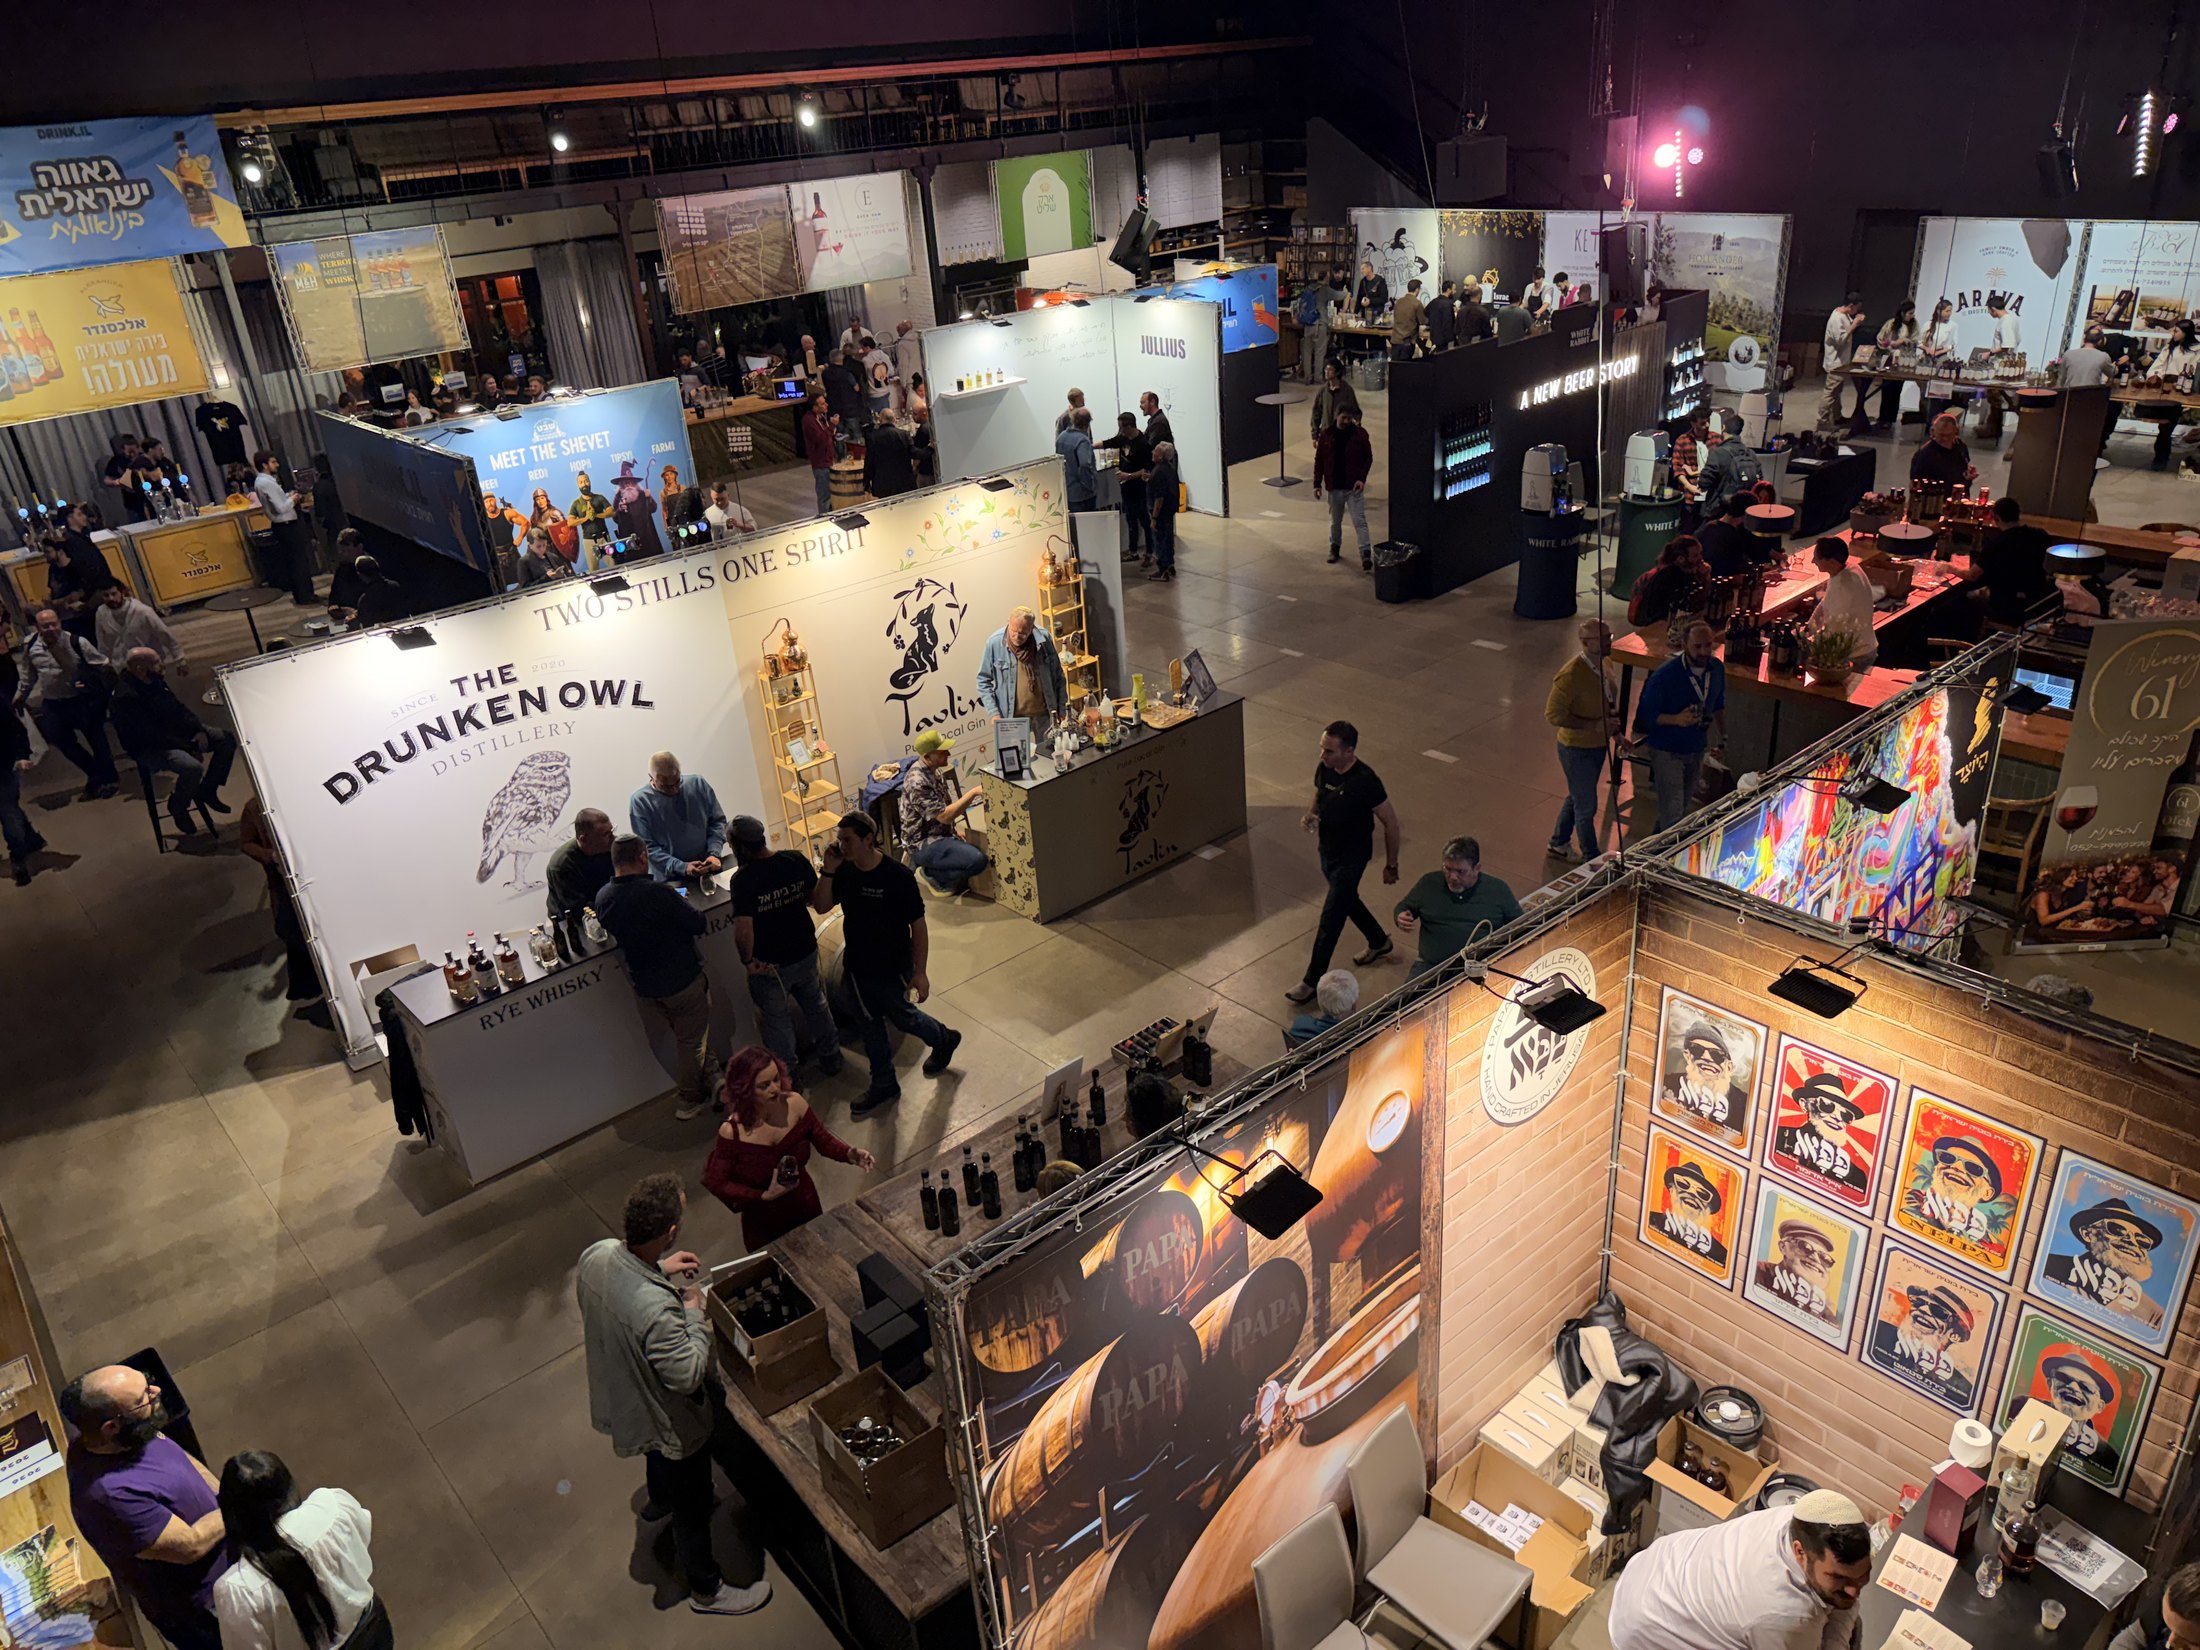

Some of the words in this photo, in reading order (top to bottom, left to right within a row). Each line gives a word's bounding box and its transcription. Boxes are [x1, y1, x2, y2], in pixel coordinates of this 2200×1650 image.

[36, 126, 92, 140] DRINK.IL
[35, 159, 121, 188] גאווה
[19, 182, 150, 218] ישראלית
[1036, 203, 1057, 215] שליט
[1037, 195, 1055, 206] ארק
[49, 204, 144, 244] בינלאומית
[318, 250, 345, 260] WHERE
[295, 276, 318, 290] M&H
[322, 268, 348, 277] MEETS
[82, 319, 147, 336] אלכסנדר
[1570, 327, 1590, 339] WHITE
[74, 339, 131, 361] ישראלית
[135, 333, 168, 353] בירה
[1140, 335, 1186, 359] JULLIUS
[82, 354, 178, 396] מעולה!
[1519, 390, 1529, 411] A
[1533, 378, 1560, 405] NEW
[1564, 368, 1594, 394] BEER
[1599, 355, 1638, 384] STORY
[536, 421, 557, 433] שבט
[490, 447, 526, 471] MEET
[532, 442, 557, 462] THE
[560, 430, 611, 456] SHEVET
[1645, 522, 1673, 532] WHITE
[1528, 537, 1556, 548] WHITE
[181, 564, 221, 578] אלכסנדר
[533, 592, 613, 631] TWO
[615, 565, 714, 612] STILLS
[722, 549, 778, 583] ONE
[786, 526, 868, 567] SPIRIT
[2126, 641, 2200, 689] Winery
[390, 692, 438, 719] SINCE
[531, 658, 566, 672] 2020
[450, 662, 519, 697] THE
[2130, 674, 2178, 721] 61
[322, 686, 548, 805] DRUNKEN
[558, 679, 655, 711] OWL
[430, 721, 576, 777] DISTILLERY
[905, 744, 917, 755] Pu
[941, 723, 965, 740] ocal
[967, 717, 986, 732] Gin
[758, 893, 770, 904] אל
[773, 886, 789, 899] בית
[791, 881, 805, 893] יקב
[758, 902, 773, 913] Beit
[774, 900, 782, 908] El
[480, 1004, 522, 1031] RYE
[526, 964, 604, 1010] WHISKY
[1489, 1000, 1516, 1048] PAPA
[1577, 961, 1591, 985] LTD
[1484, 1067, 1496, 1105] HAND
[1494, 1101, 1539, 1123] CRAFTED
[1539, 1092, 1551, 1104] IN
[1552, 1027, 1587, 1090] JERUSAL
[1794, 1163, 1824, 1182] אדומה
[1122, 1224, 1196, 1285] PAPA
[1909, 1219, 1993, 1264] NEIPA
[969, 1274, 1073, 1349] PAPA
[1231, 1291, 1302, 1355] PAPA
[1892, 1361, 1924, 1381] סטאוט
[1100, 1353, 1190, 1432] PAPA
[1924, 1377, 1947, 1394] בירת
